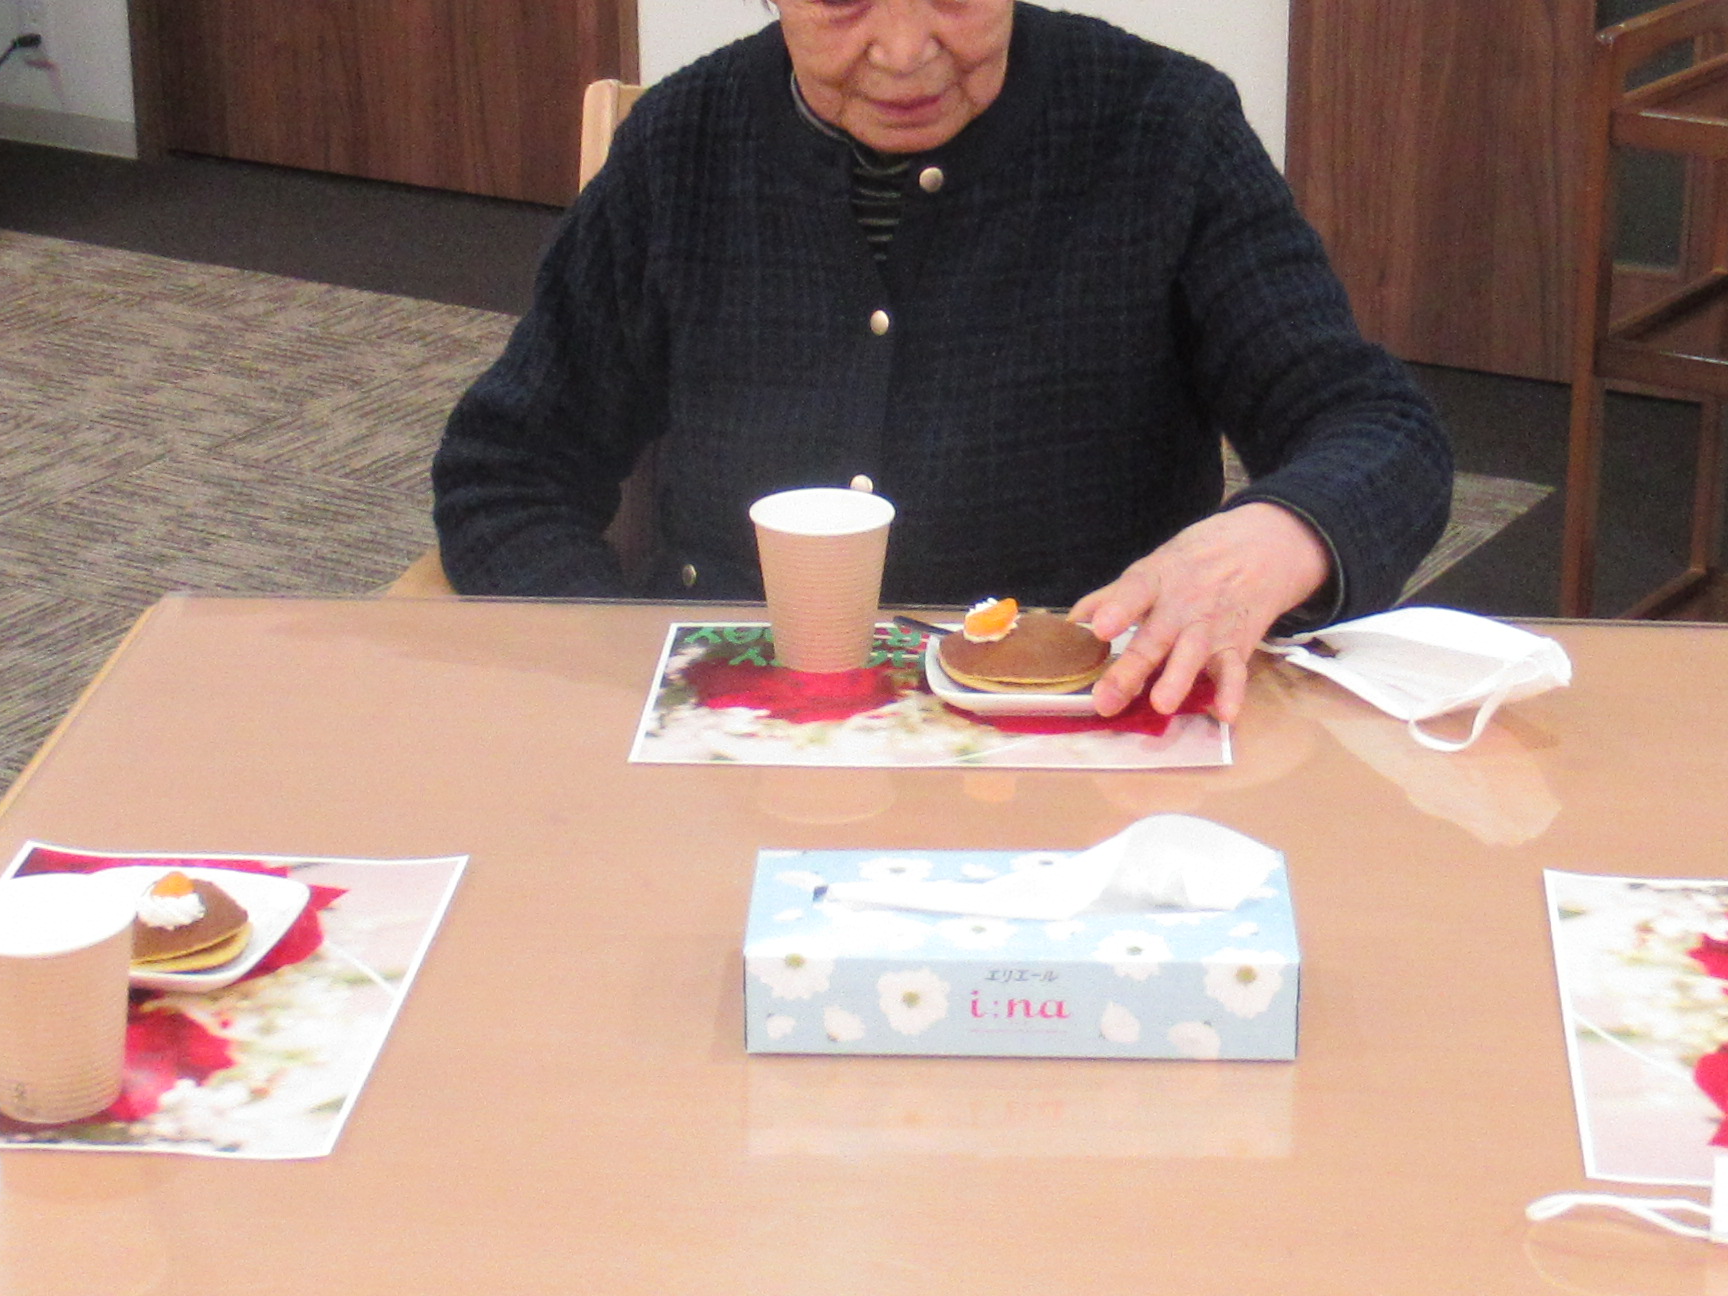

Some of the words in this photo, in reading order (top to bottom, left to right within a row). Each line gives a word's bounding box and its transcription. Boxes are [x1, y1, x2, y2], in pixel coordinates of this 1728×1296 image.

[984, 969, 1059, 983] エリエール
